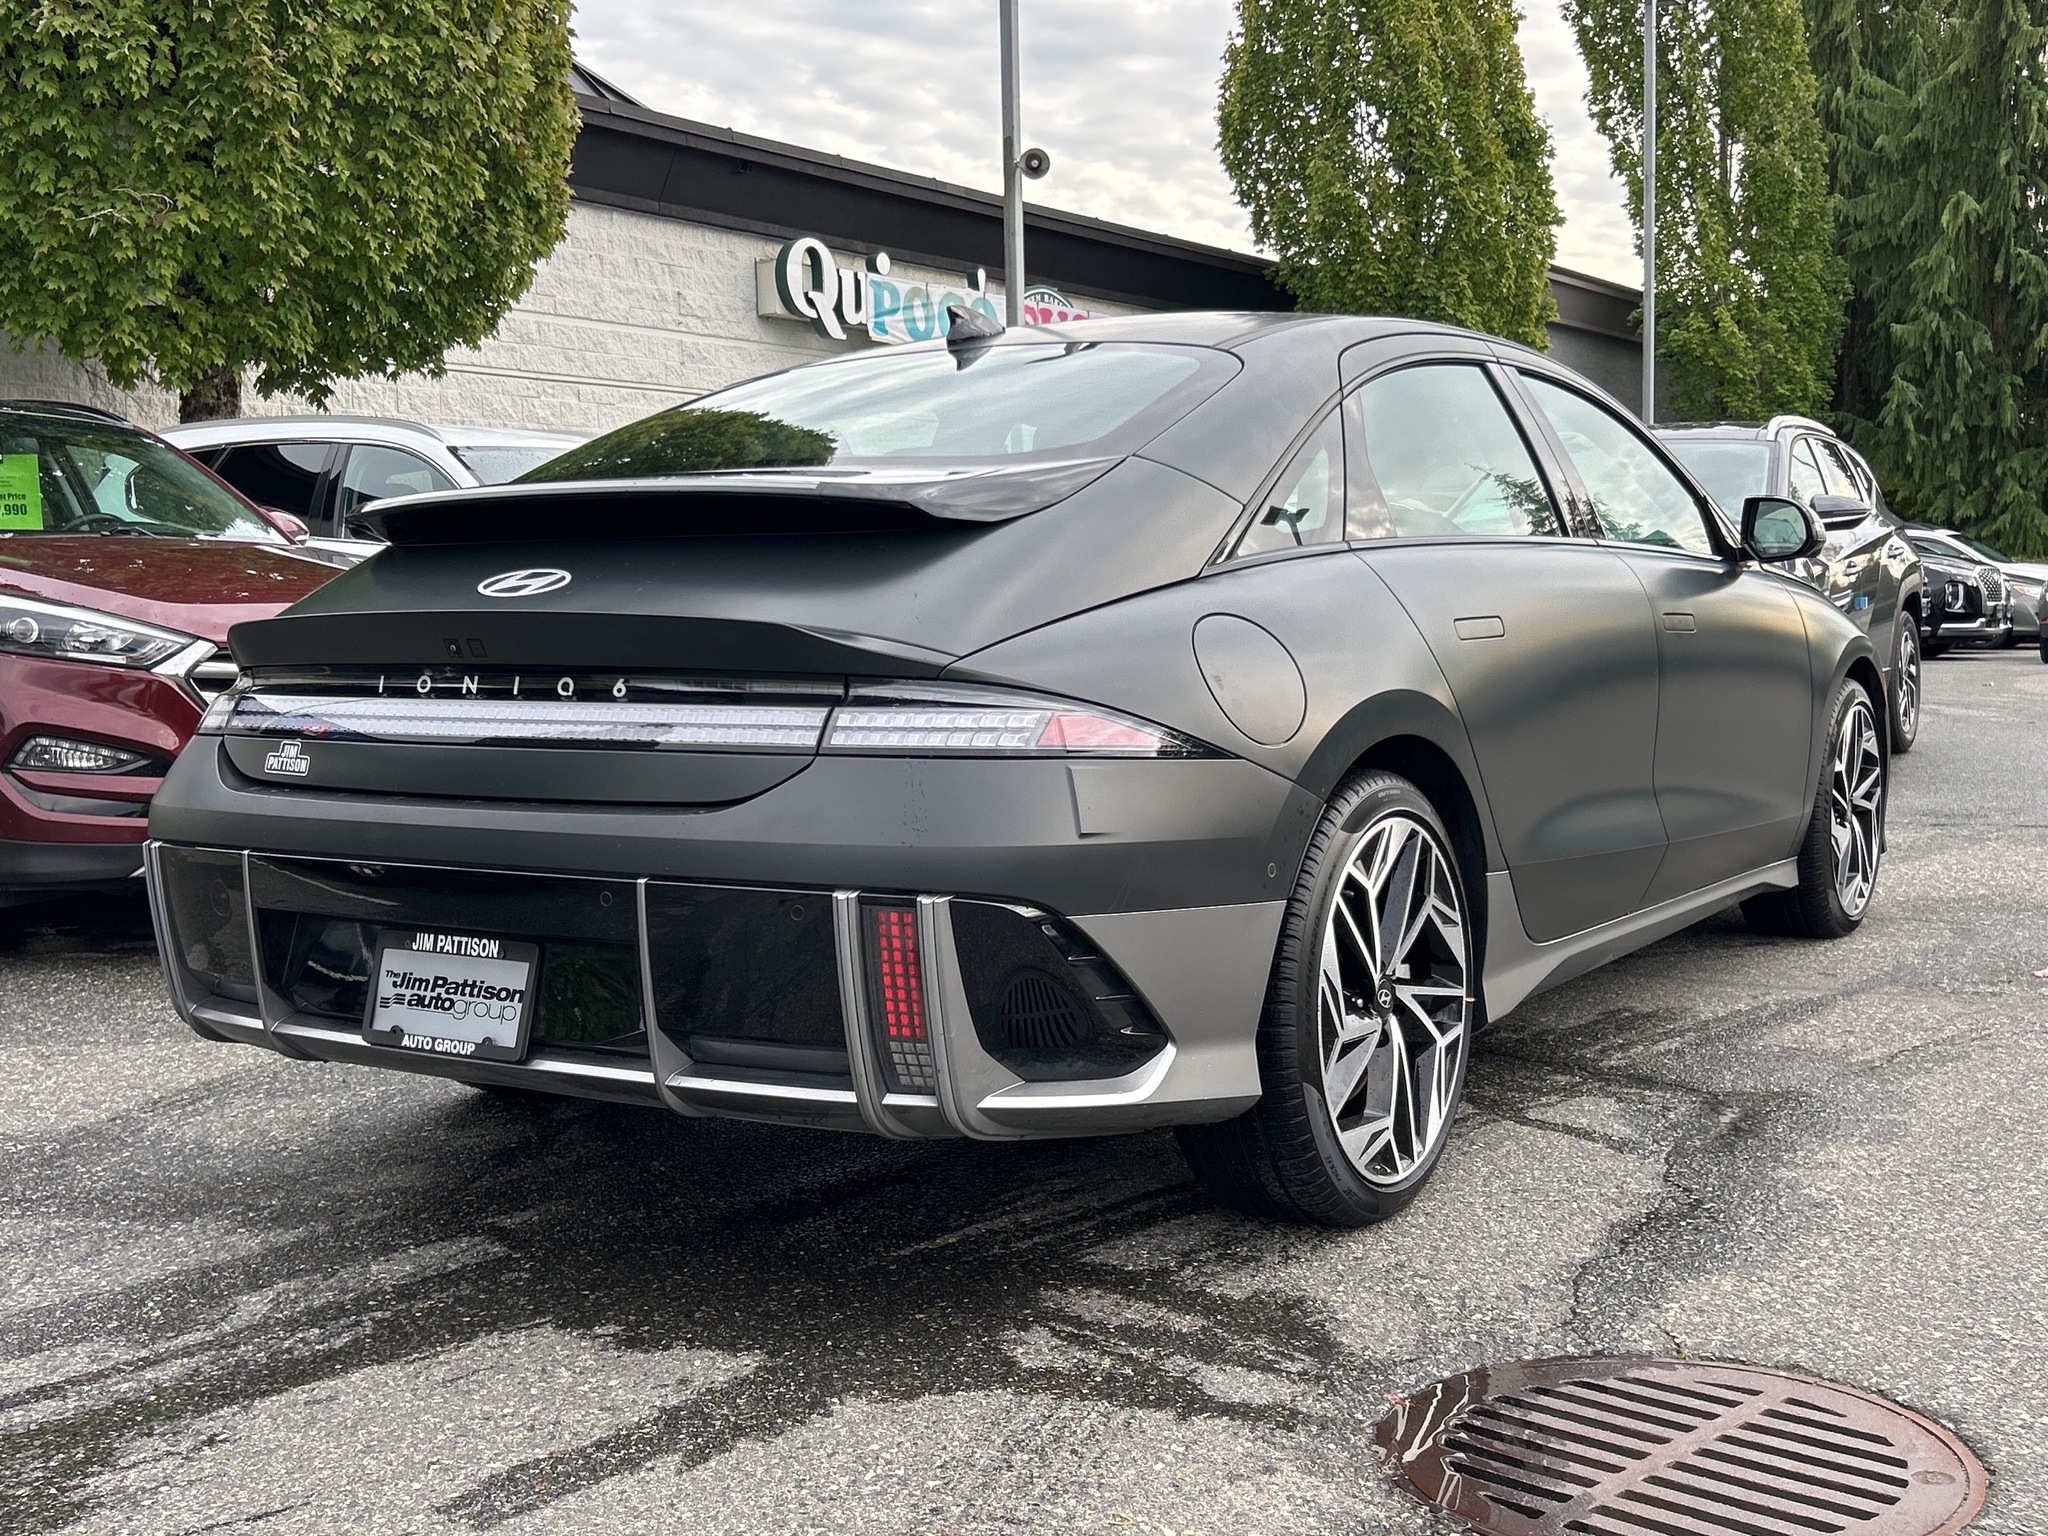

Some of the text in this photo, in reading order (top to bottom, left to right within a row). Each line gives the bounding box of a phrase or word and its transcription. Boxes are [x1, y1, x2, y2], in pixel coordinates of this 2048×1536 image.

[0, 503, 28, 517] ,990
[378, 675, 627, 698] IONIQ 6
[281, 744, 298, 758] JIM
[267, 756, 307, 772] PATTISON
[412, 933, 499, 958] JIM PATTISON
[386, 969, 401, 979] The
[401, 1034, 476, 1055] AUTO GROUP
